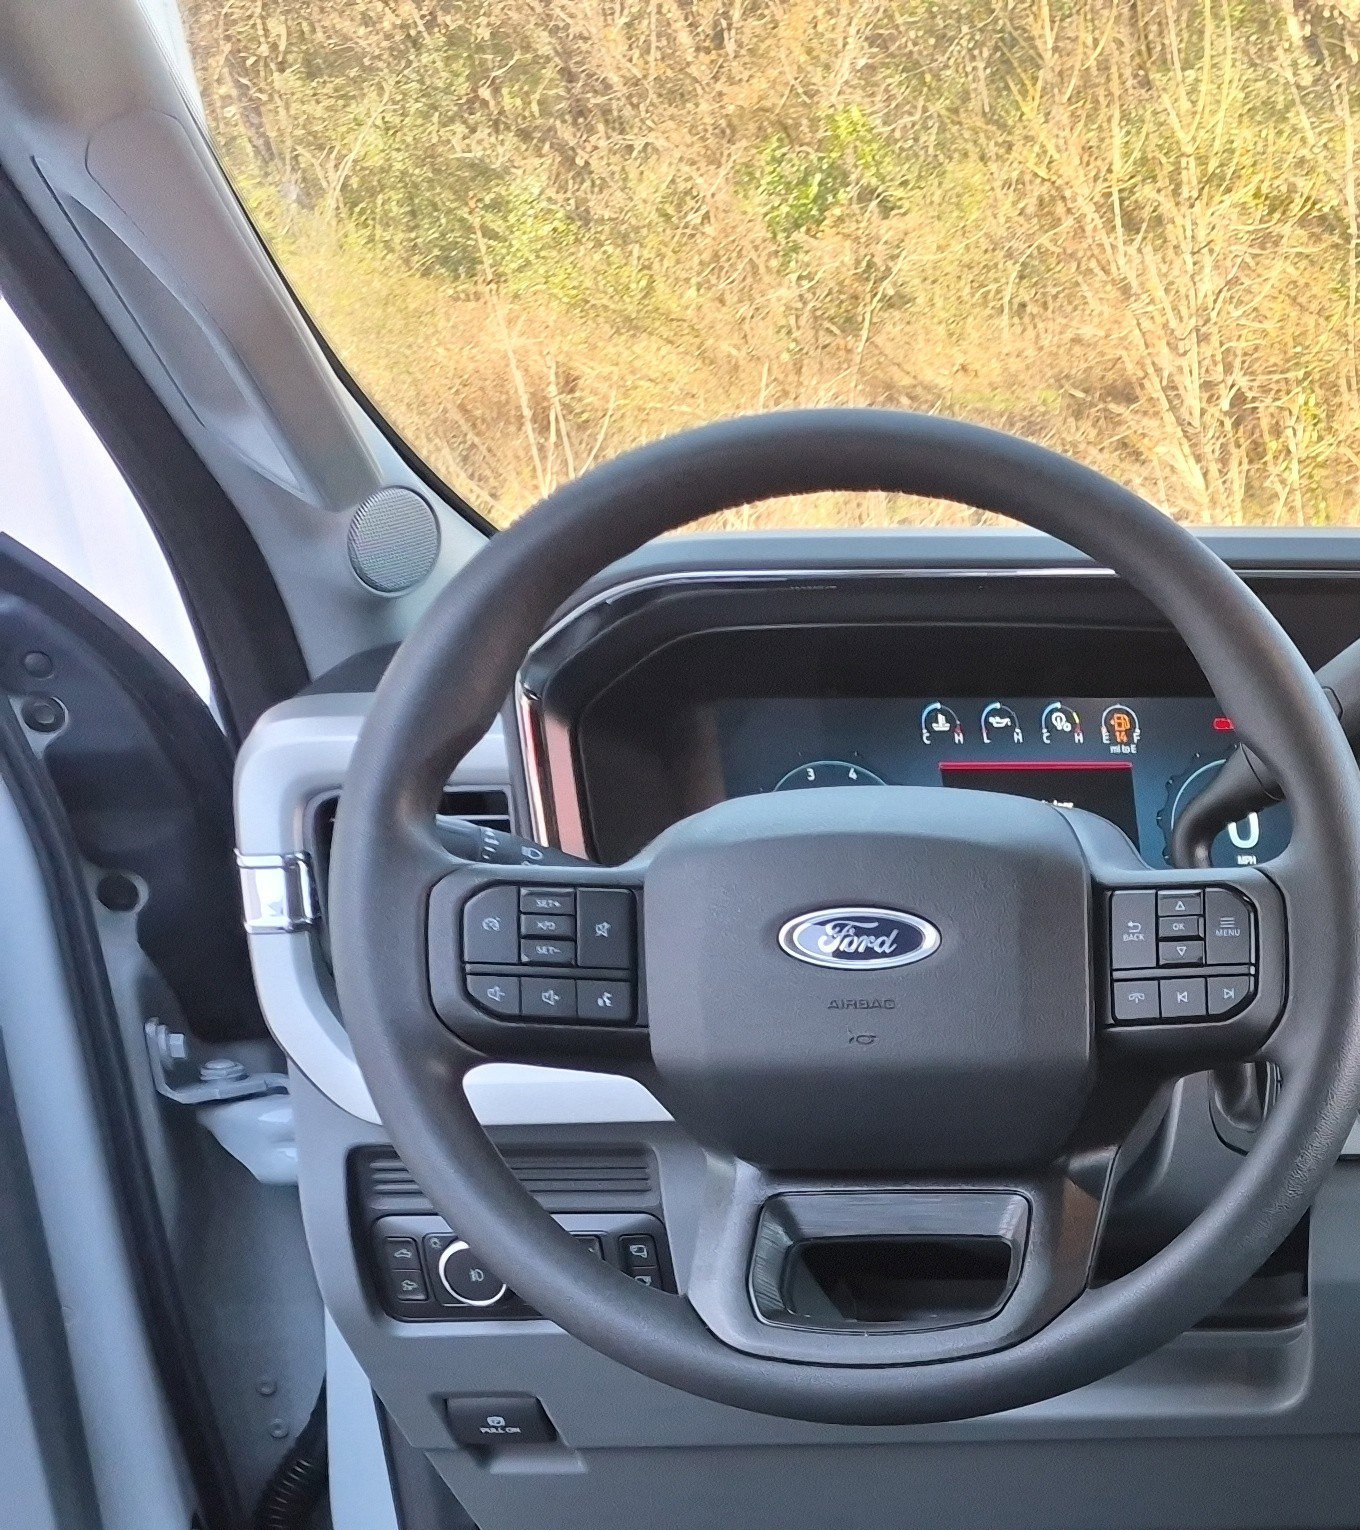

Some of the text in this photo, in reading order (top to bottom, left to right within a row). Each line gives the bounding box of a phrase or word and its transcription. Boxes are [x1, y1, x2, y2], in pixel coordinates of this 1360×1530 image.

[806, 767, 815, 781] 3
[848, 767, 857, 780] 4
[1237, 855, 1257, 865] MPH
[1172, 923, 1185, 931] OK
[817, 920, 900, 954] Ford
[1122, 933, 1145, 942] BACK
[1215, 929, 1241, 937] MENU
[827, 999, 896, 1010] AIRBAG
